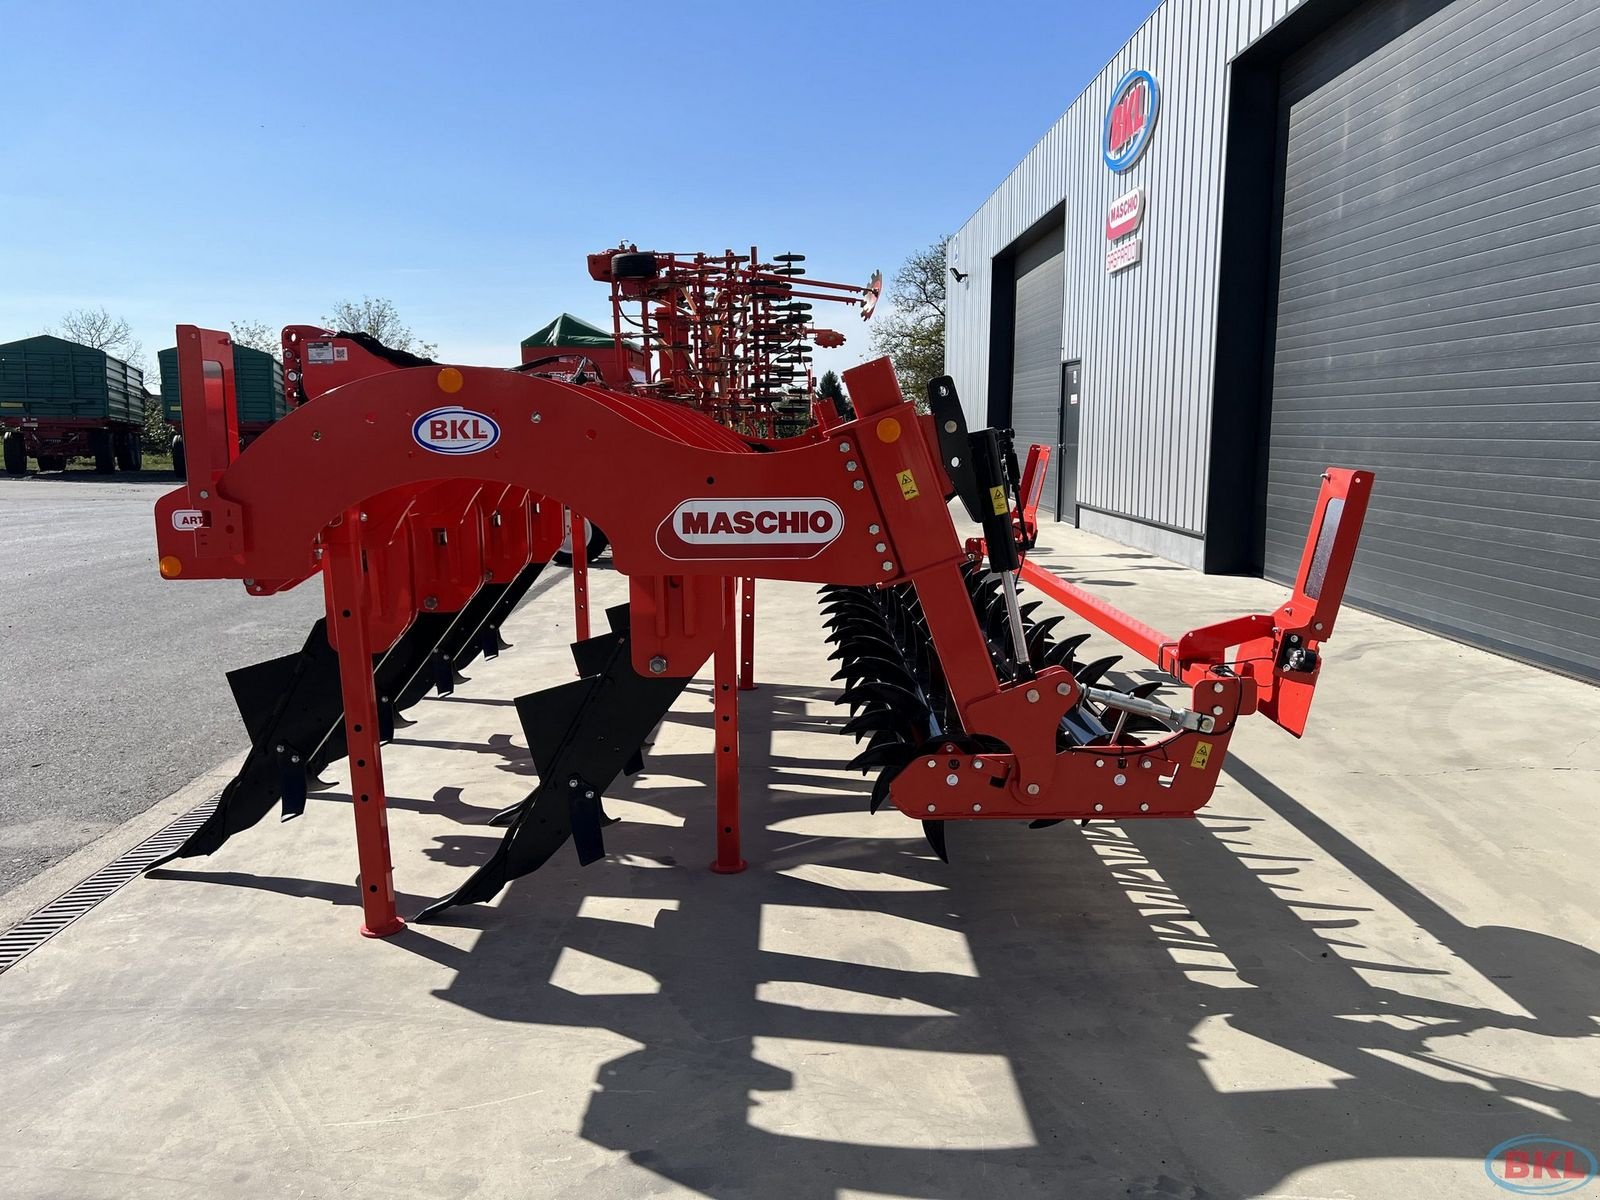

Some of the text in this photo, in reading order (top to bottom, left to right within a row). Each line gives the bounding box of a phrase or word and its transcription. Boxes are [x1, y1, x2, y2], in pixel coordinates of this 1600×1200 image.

[1110, 84, 1144, 152] BKL
[1110, 194, 1138, 222] MASCHIO
[430, 419, 488, 440] BKL
[682, 510, 833, 534] MASCHIO
